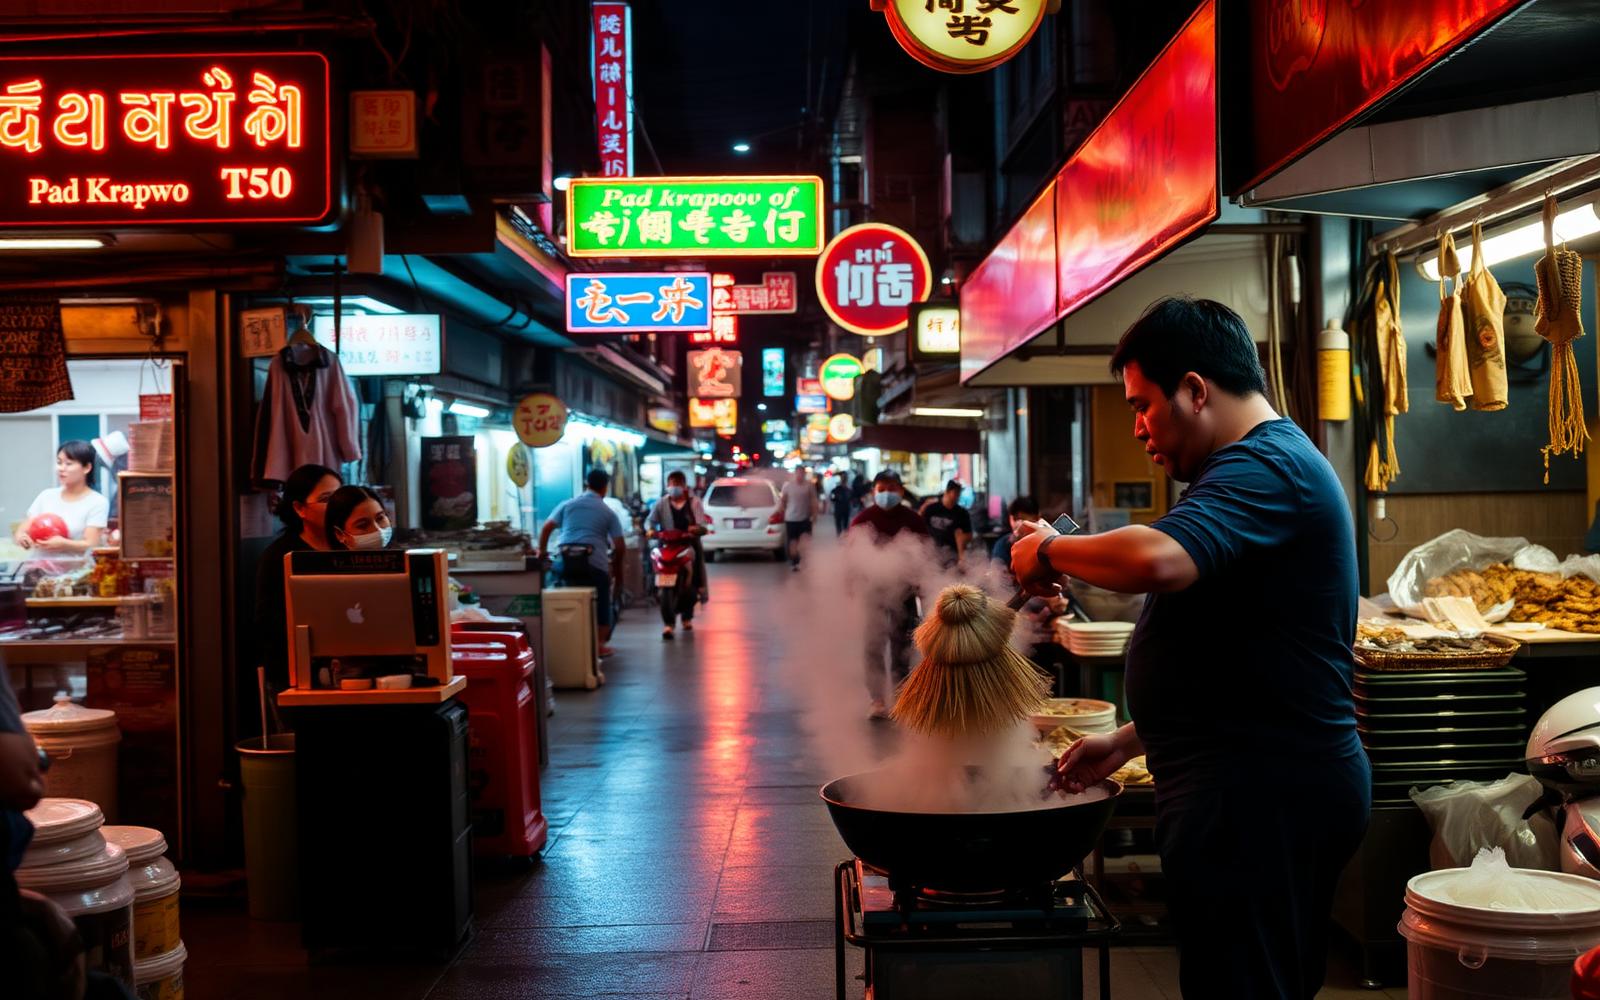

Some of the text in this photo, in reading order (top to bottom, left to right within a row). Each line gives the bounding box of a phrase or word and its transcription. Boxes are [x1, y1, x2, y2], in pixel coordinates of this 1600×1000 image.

[29, 178, 189, 209] Pad Krapwo
[221, 167, 292, 199] T50
[601, 187, 653, 208] Pad
[768, 186, 800, 209] of
